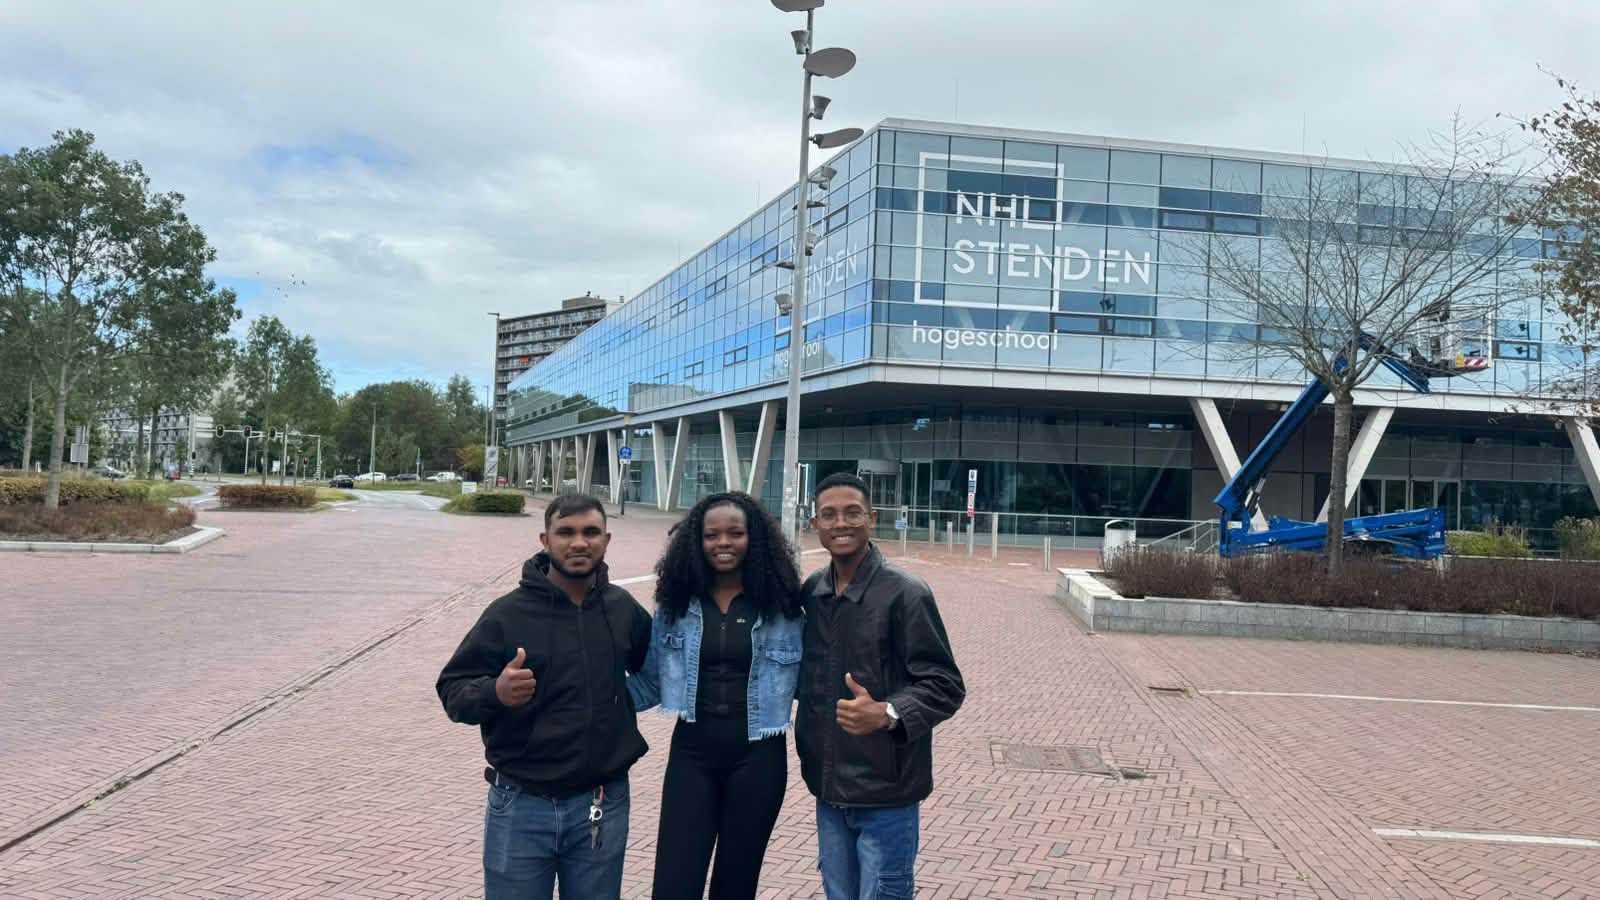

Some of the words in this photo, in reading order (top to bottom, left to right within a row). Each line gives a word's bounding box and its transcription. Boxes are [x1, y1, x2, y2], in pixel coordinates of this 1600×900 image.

[956, 190, 1061, 230] NHL
[952, 239, 1150, 285] STENDEN
[912, 320, 1058, 350] hogeschool
